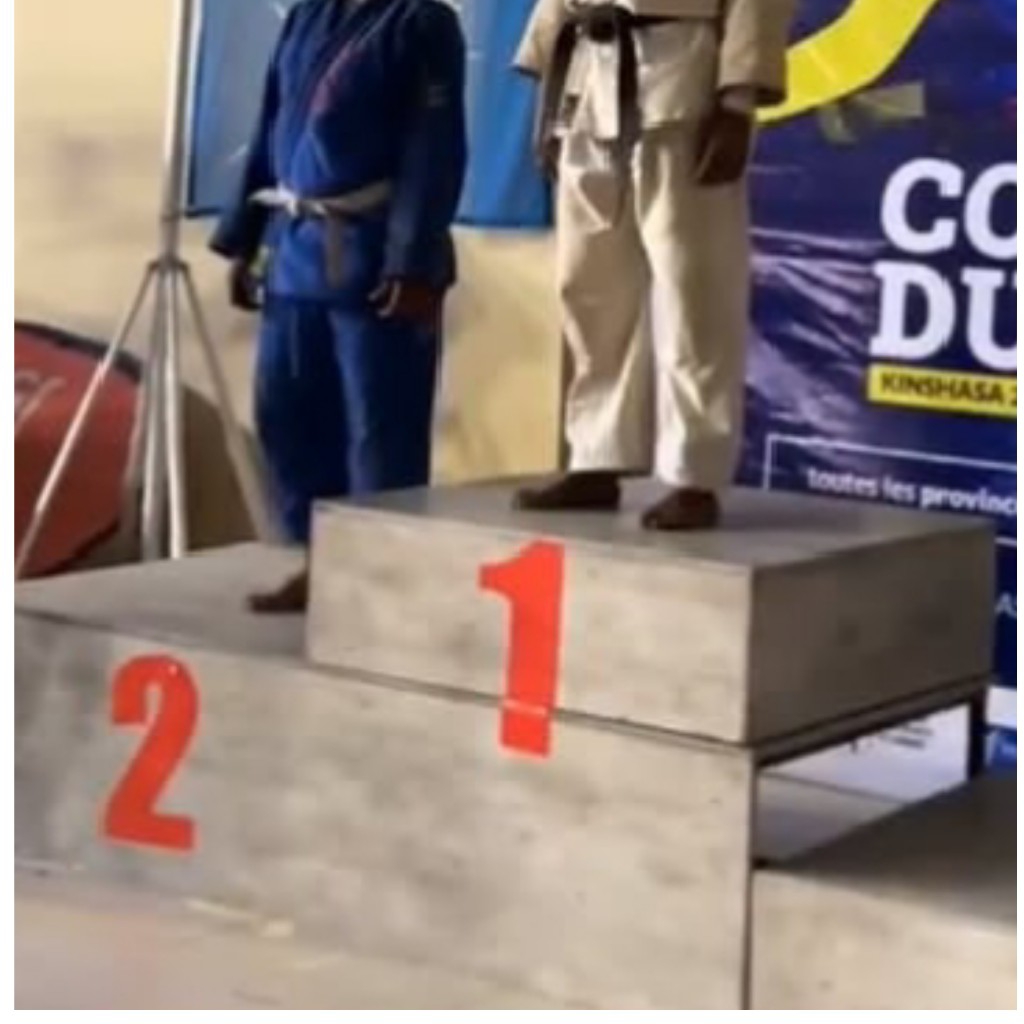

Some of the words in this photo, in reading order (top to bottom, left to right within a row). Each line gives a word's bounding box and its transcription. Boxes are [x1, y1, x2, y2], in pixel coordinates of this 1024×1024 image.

[868, 259, 1017, 372] DU
[879, 372, 1004, 405] KINSHASA
[806, 467, 878, 498] toutes
[882, 476, 916, 503] les
[478, 539, 565, 757] 1
[103, 653, 200, 852] 2
